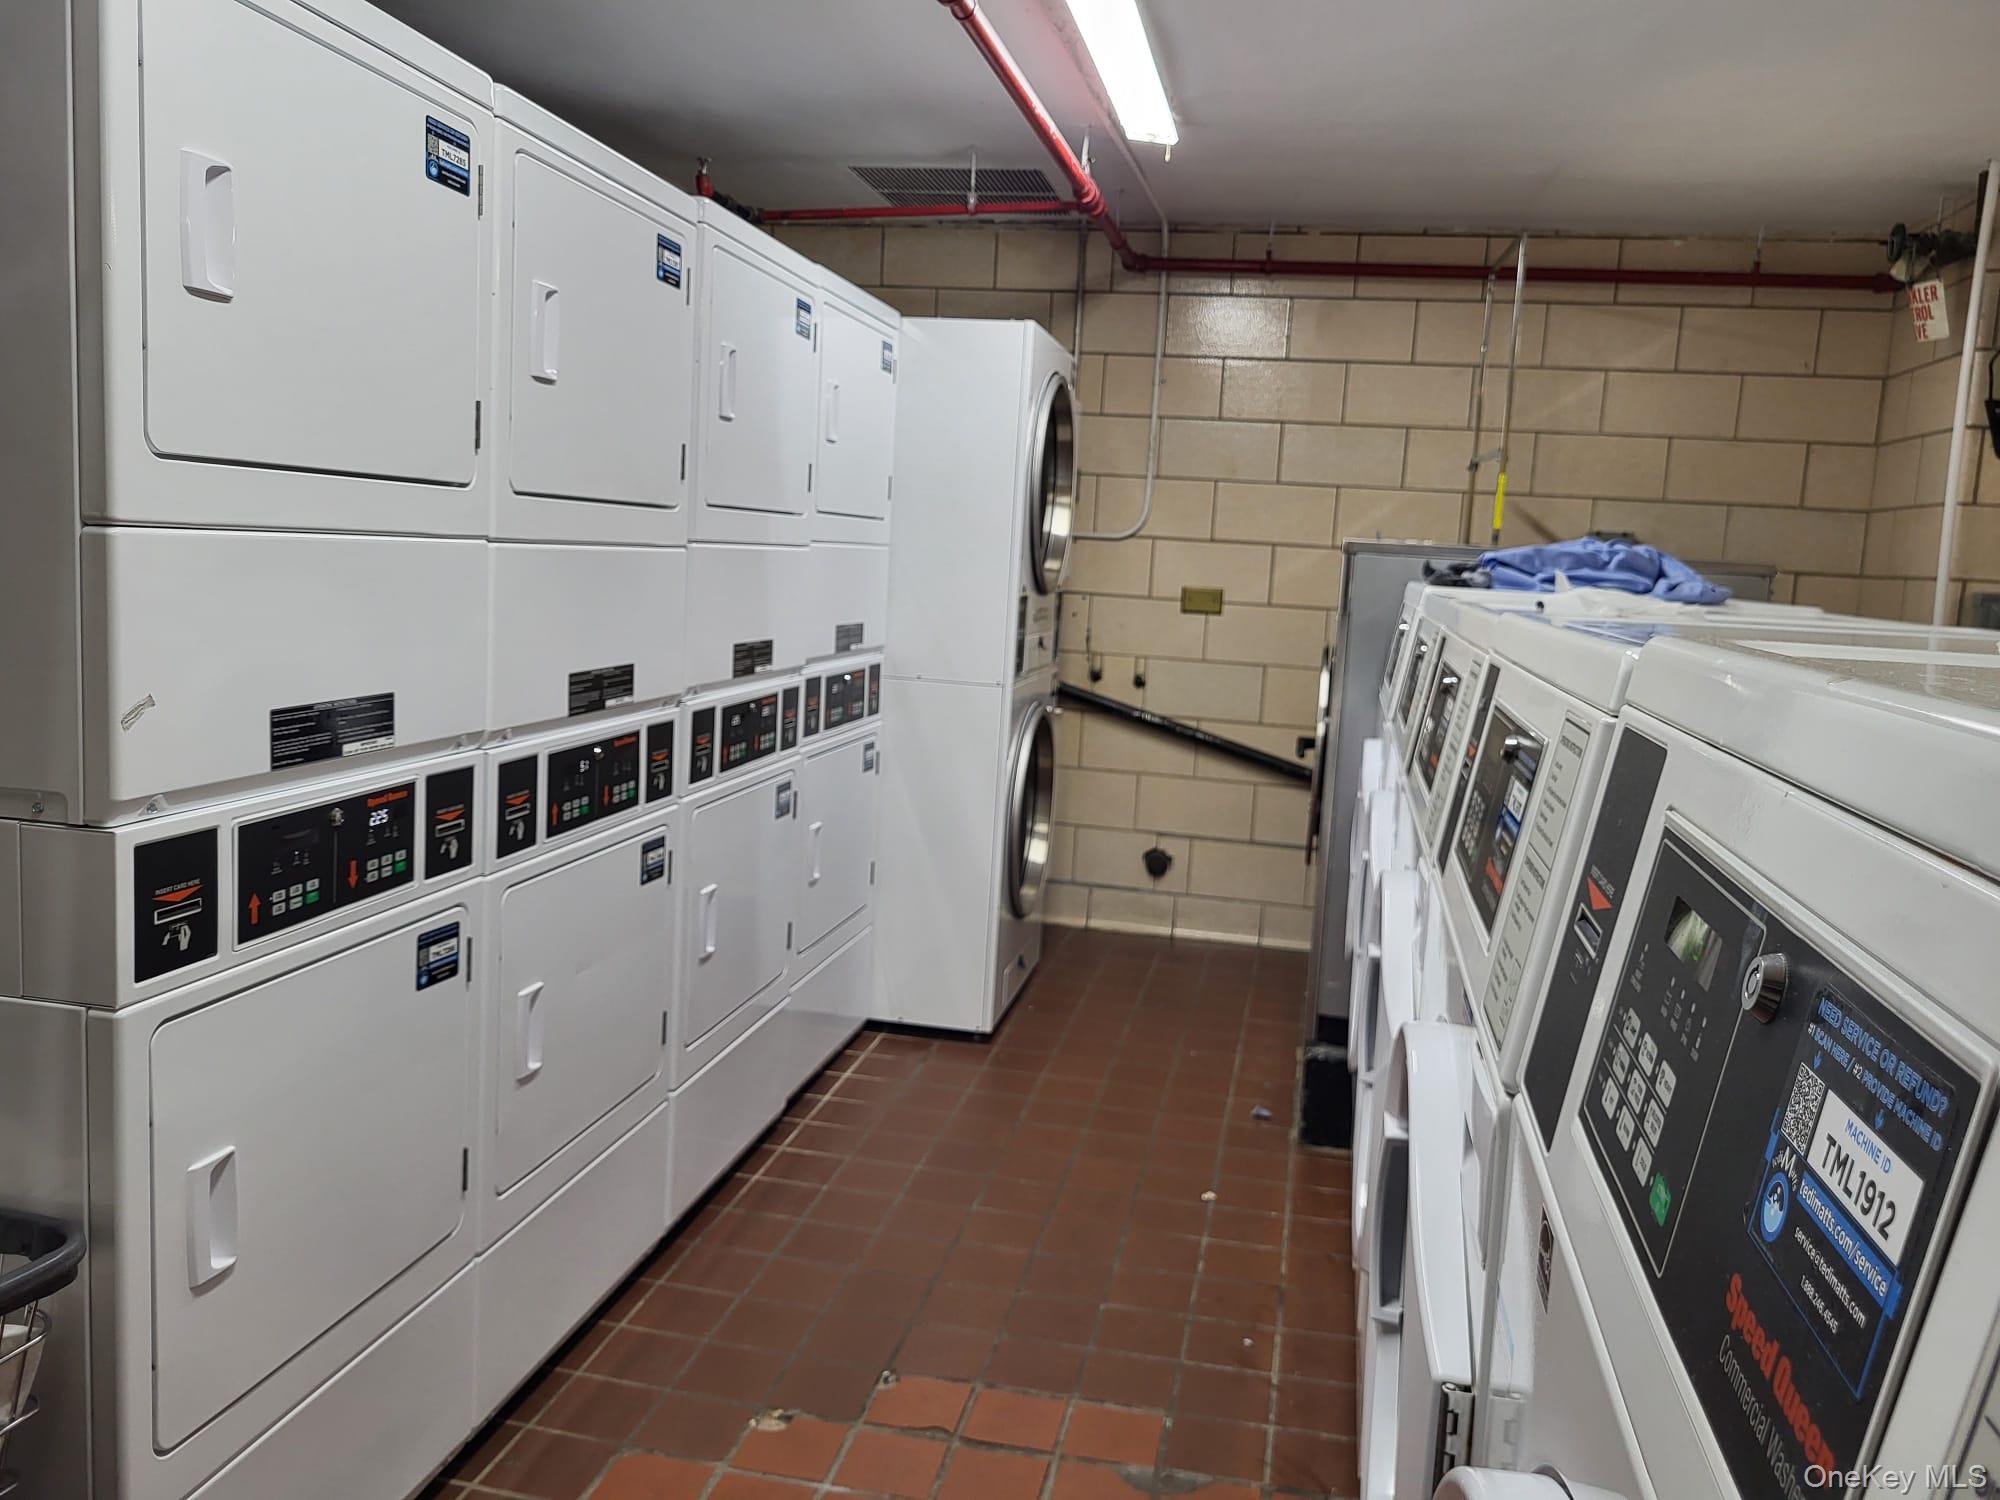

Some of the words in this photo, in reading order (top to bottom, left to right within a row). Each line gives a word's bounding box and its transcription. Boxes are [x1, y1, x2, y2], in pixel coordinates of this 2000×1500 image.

[1813, 1027, 1833, 1051] SCAN
[1830, 1041, 1850, 1068] HERE
[1852, 1063, 1863, 1080] #2
[1860, 1069, 1894, 1110] PROVIDE
[1891, 1098, 1933, 1141] MACHINE
[1928, 1131, 1943, 1151] ID
[1817, 997, 1843, 1030] NEED
[1841, 1016, 1881, 1063] SERVICE
[1879, 1047, 1898, 1078] OR
[1894, 1059, 1948, 1118] REFUND?
[1821, 1133, 1897, 1241] TML1912
[1844, 1118, 1881, 1165] MACHINE
[1880, 1157, 1892, 1174] ID
[1794, 1227, 1866, 1329] service@tedimatts.com
[1800, 1178, 1886, 1297] tedimatts.com/service
[1719, 1334, 1770, 1447] Commercial
[1725, 1272, 1780, 1381] Speed
[1772, 1355, 1835, 1490] Queen
